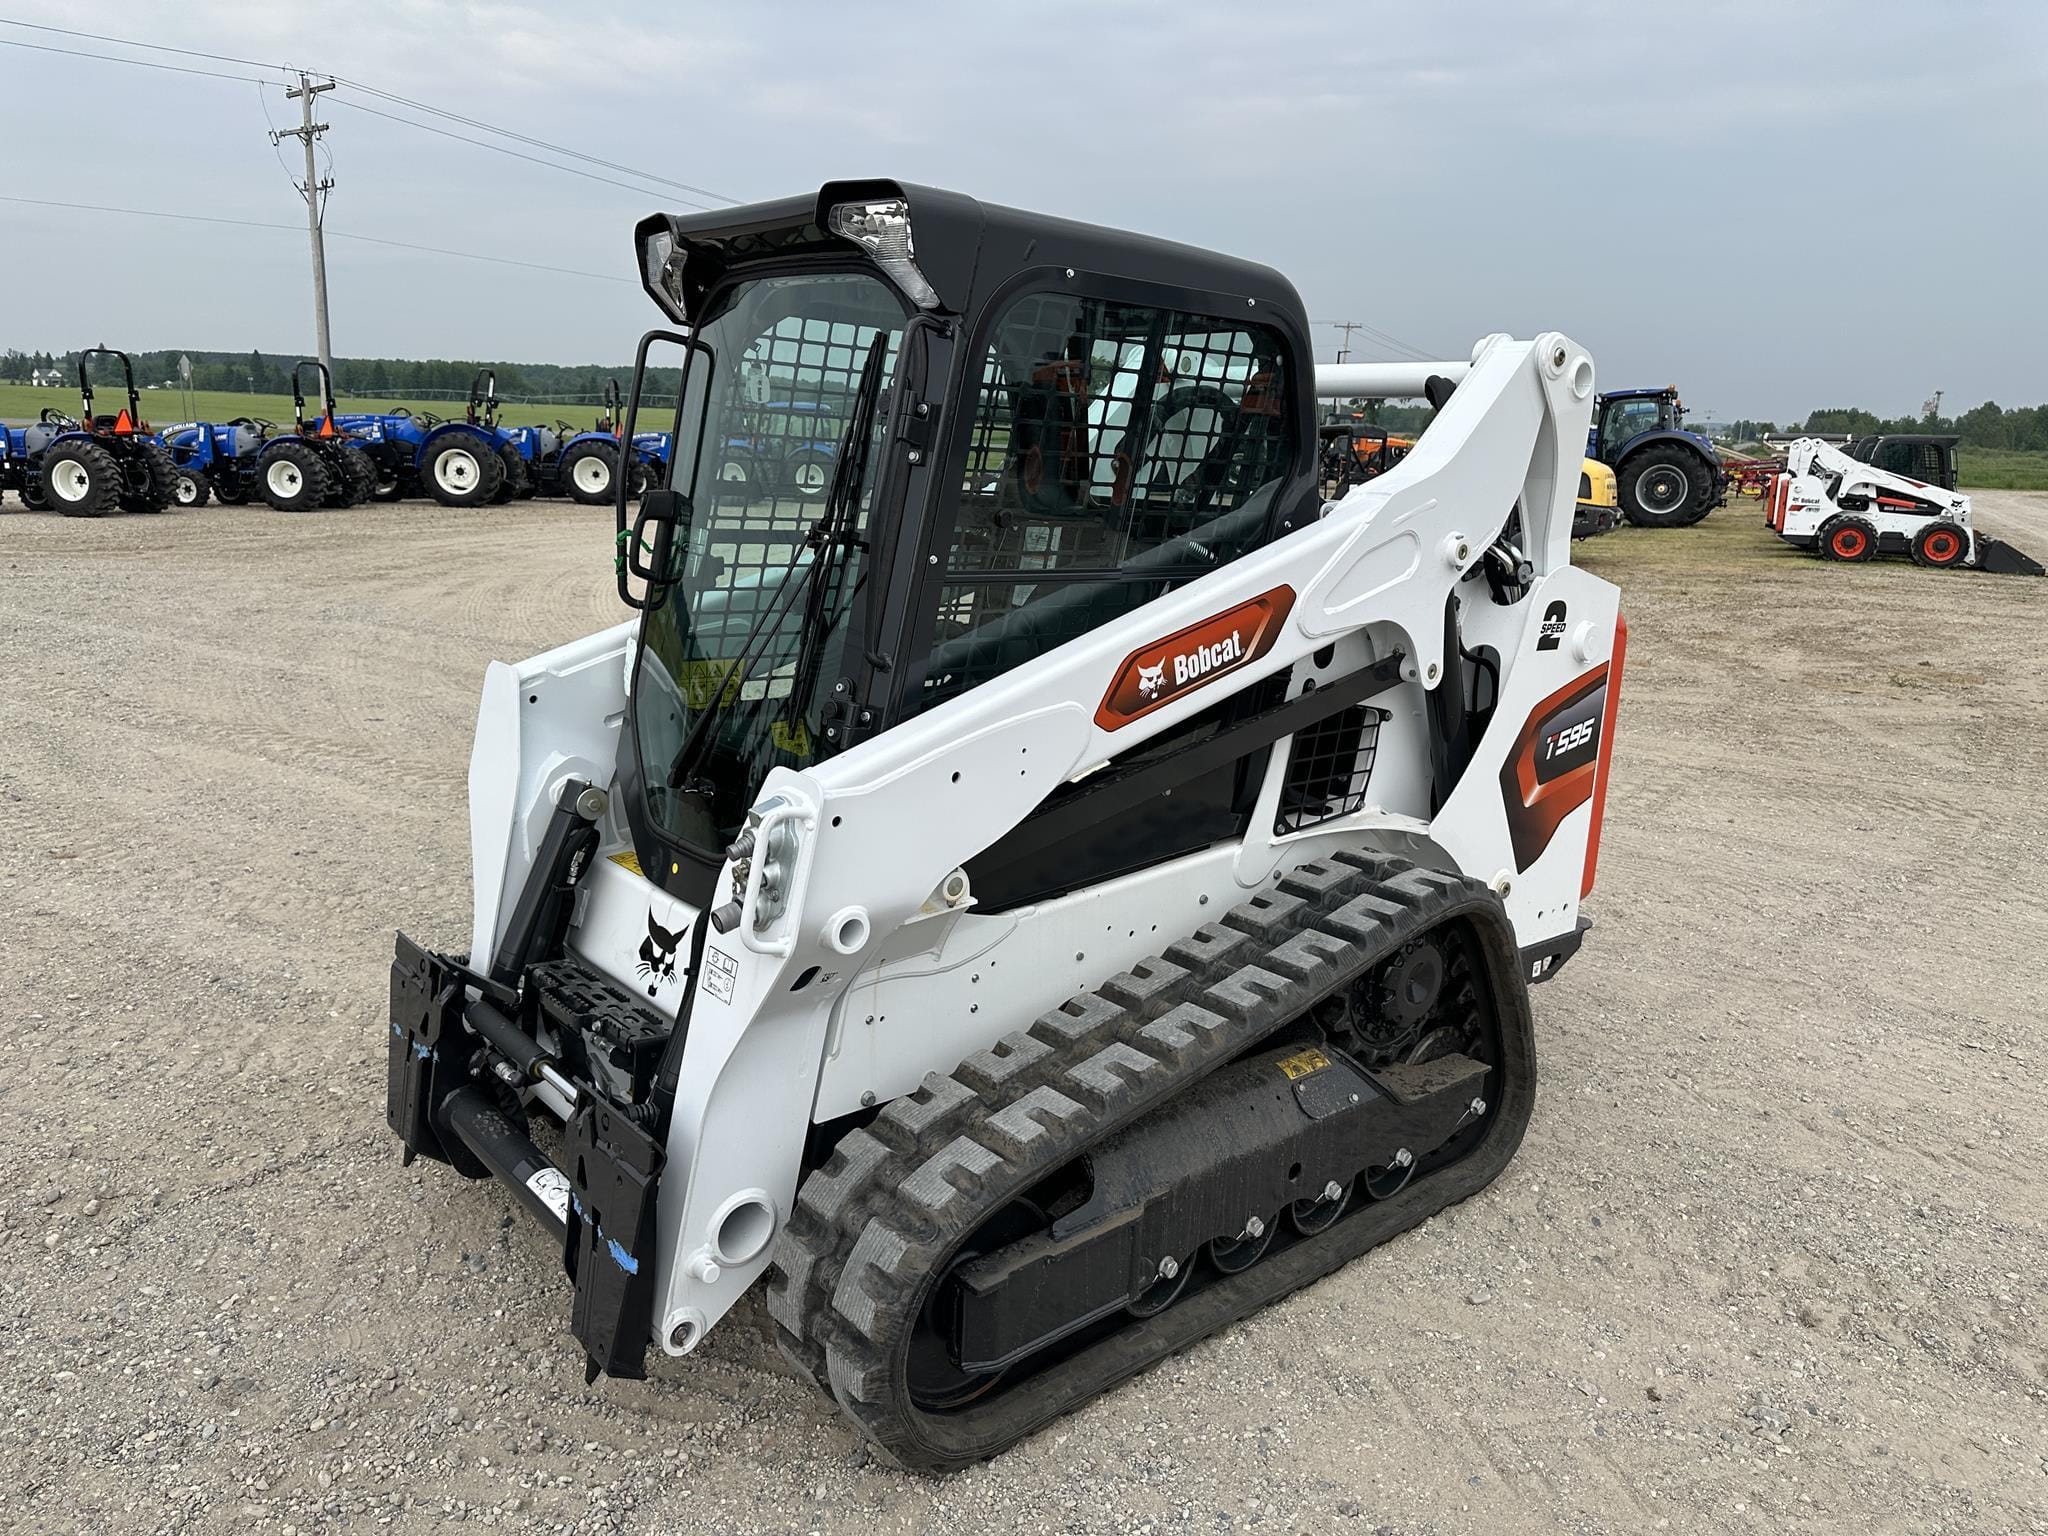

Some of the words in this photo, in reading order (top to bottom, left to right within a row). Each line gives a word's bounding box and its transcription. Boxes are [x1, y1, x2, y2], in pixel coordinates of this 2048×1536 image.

[162, 428, 173, 436] NEW
[173, 422, 197, 430] HOLLAND
[1536, 600, 1567, 651] 2
[1540, 622, 1567, 634] SPEED
[1173, 629, 1242, 686] Bobcat
[1546, 717, 1596, 761] T595
